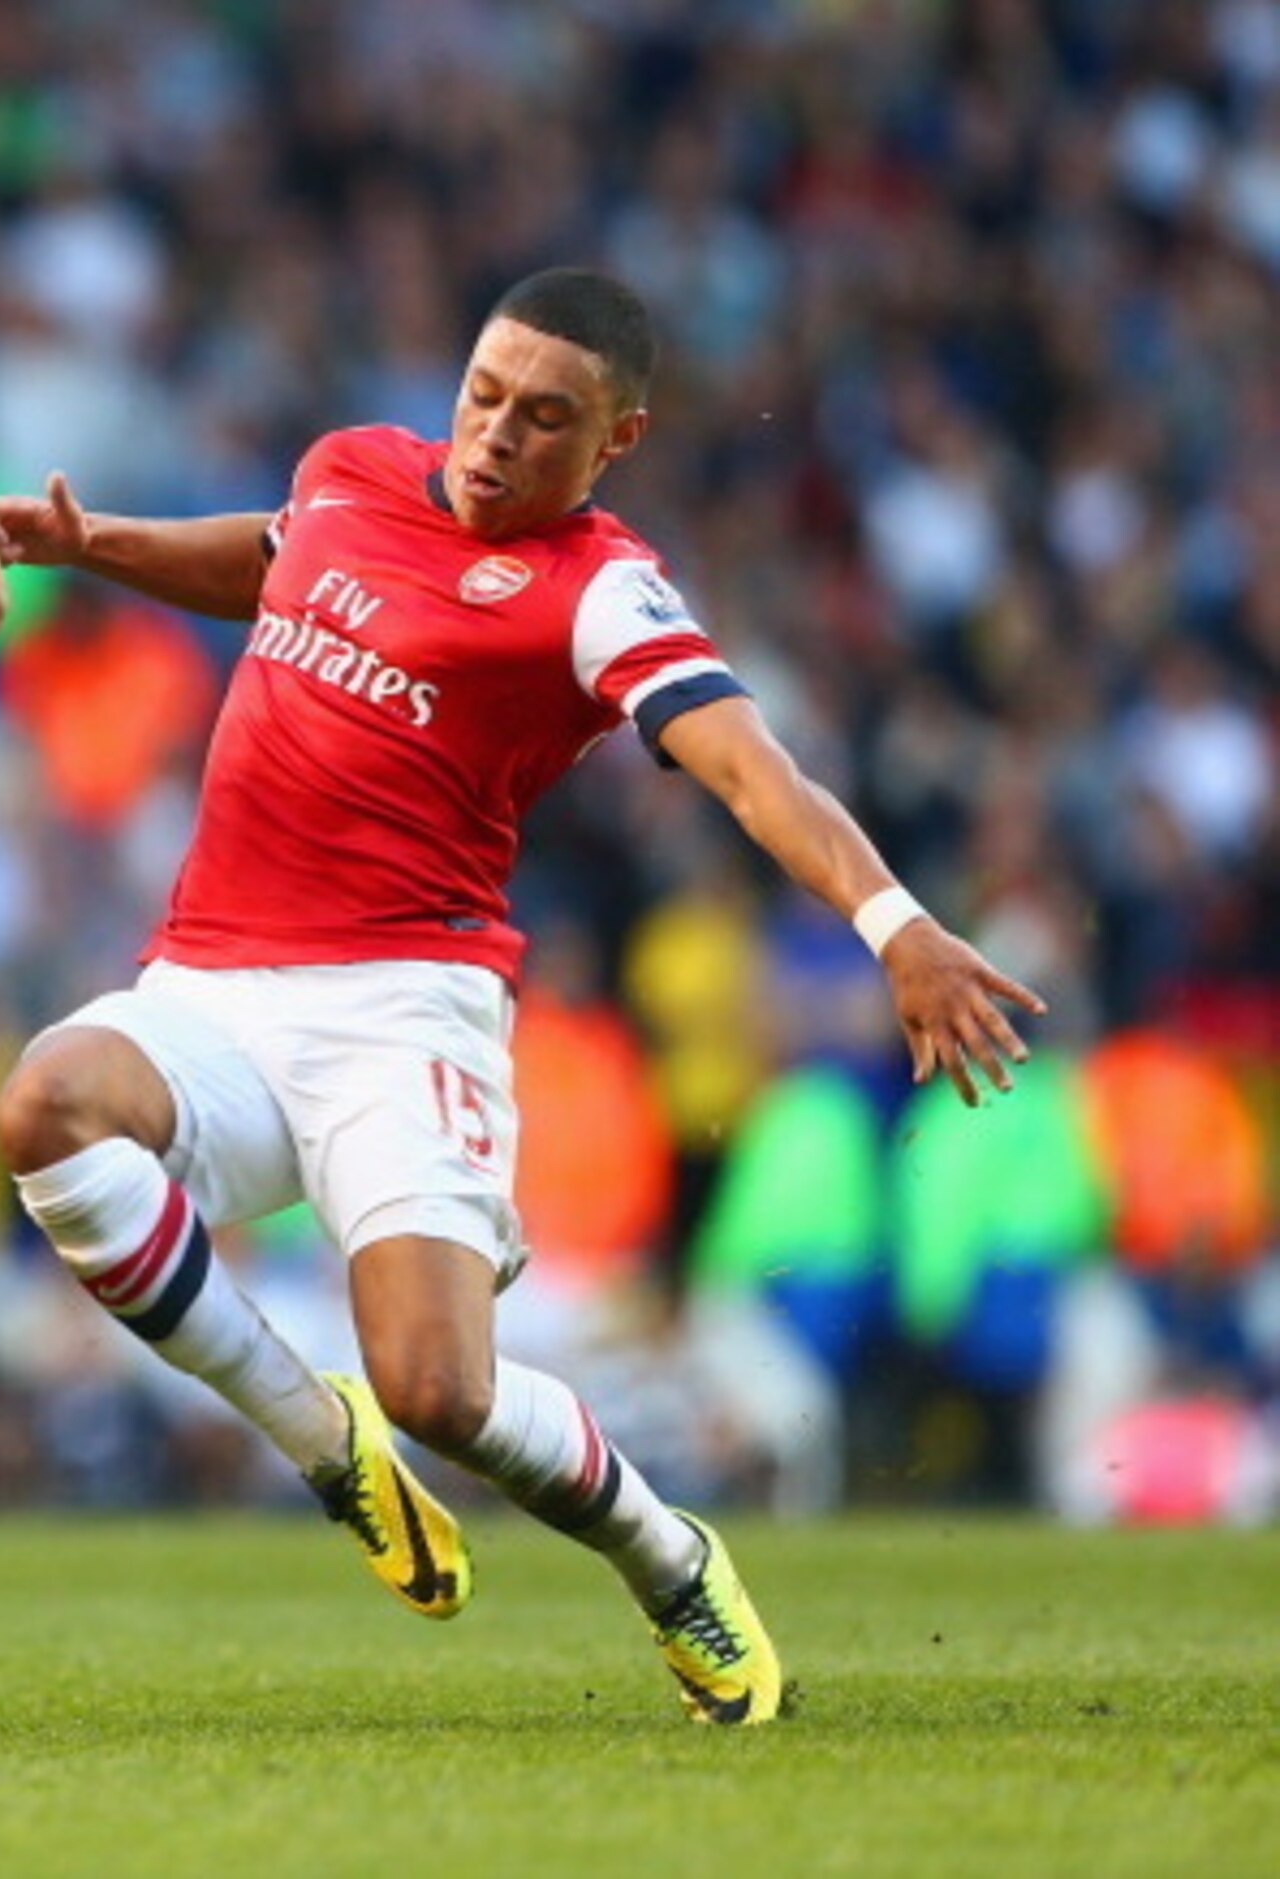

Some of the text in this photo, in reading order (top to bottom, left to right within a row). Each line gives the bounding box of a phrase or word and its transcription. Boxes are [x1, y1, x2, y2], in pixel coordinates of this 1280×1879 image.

[306, 567, 384, 630] Fly
[245, 610, 440, 727] mirates
[428, 1057, 492, 1157] 15
